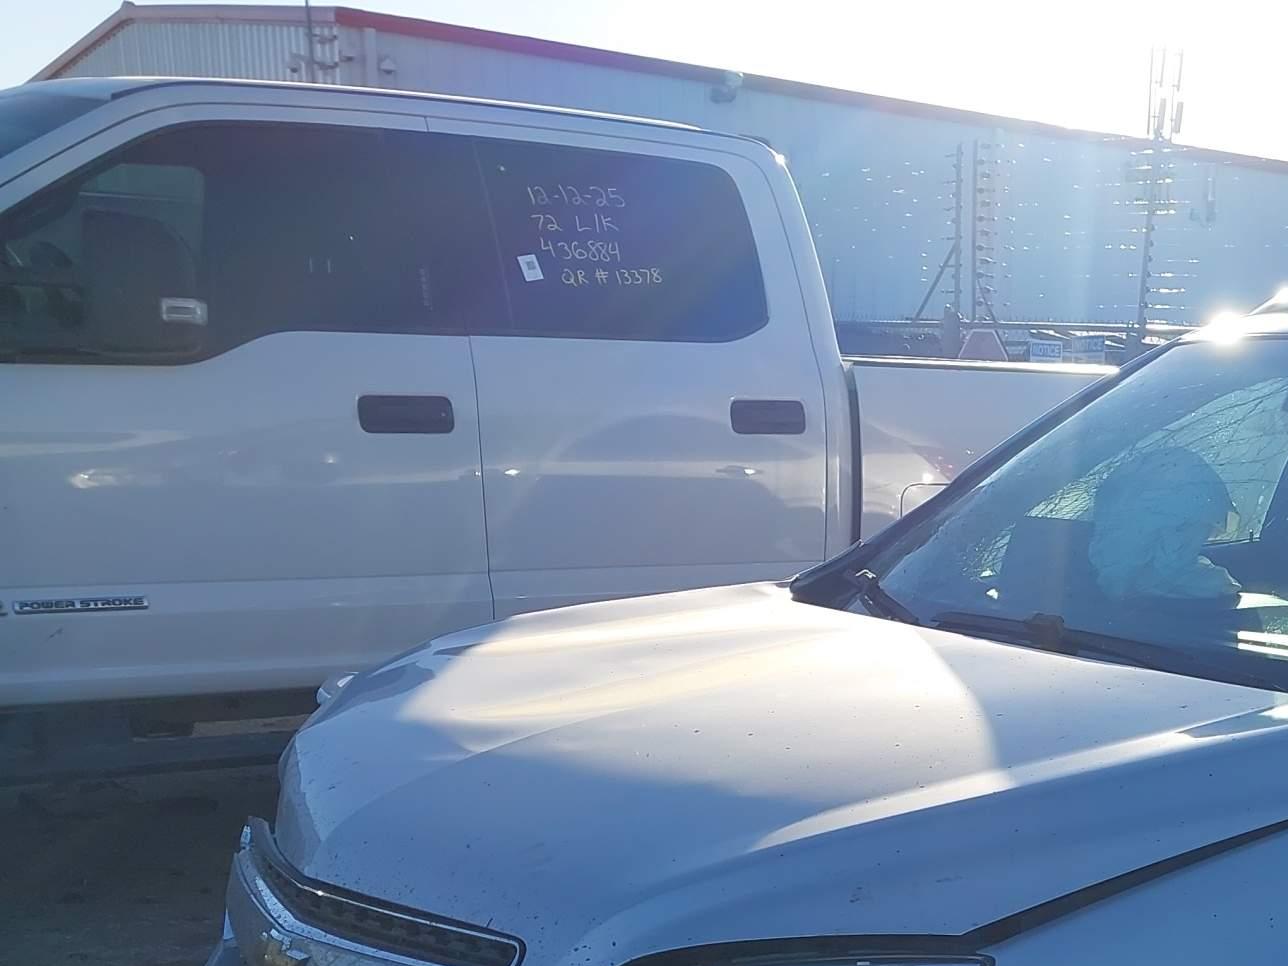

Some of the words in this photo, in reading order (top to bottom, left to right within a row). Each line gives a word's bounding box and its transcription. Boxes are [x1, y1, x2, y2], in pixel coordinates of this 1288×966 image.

[527, 183, 626, 208] 12-12-25
[530, 214, 563, 232] 72
[539, 236, 621, 263] 436884
[561, 267, 590, 287] QR
[594, 267, 609, 286] #
[615, 268, 663, 286] 13378
[19, 600, 75, 610] POWER
[79, 598, 145, 608] STROKE
